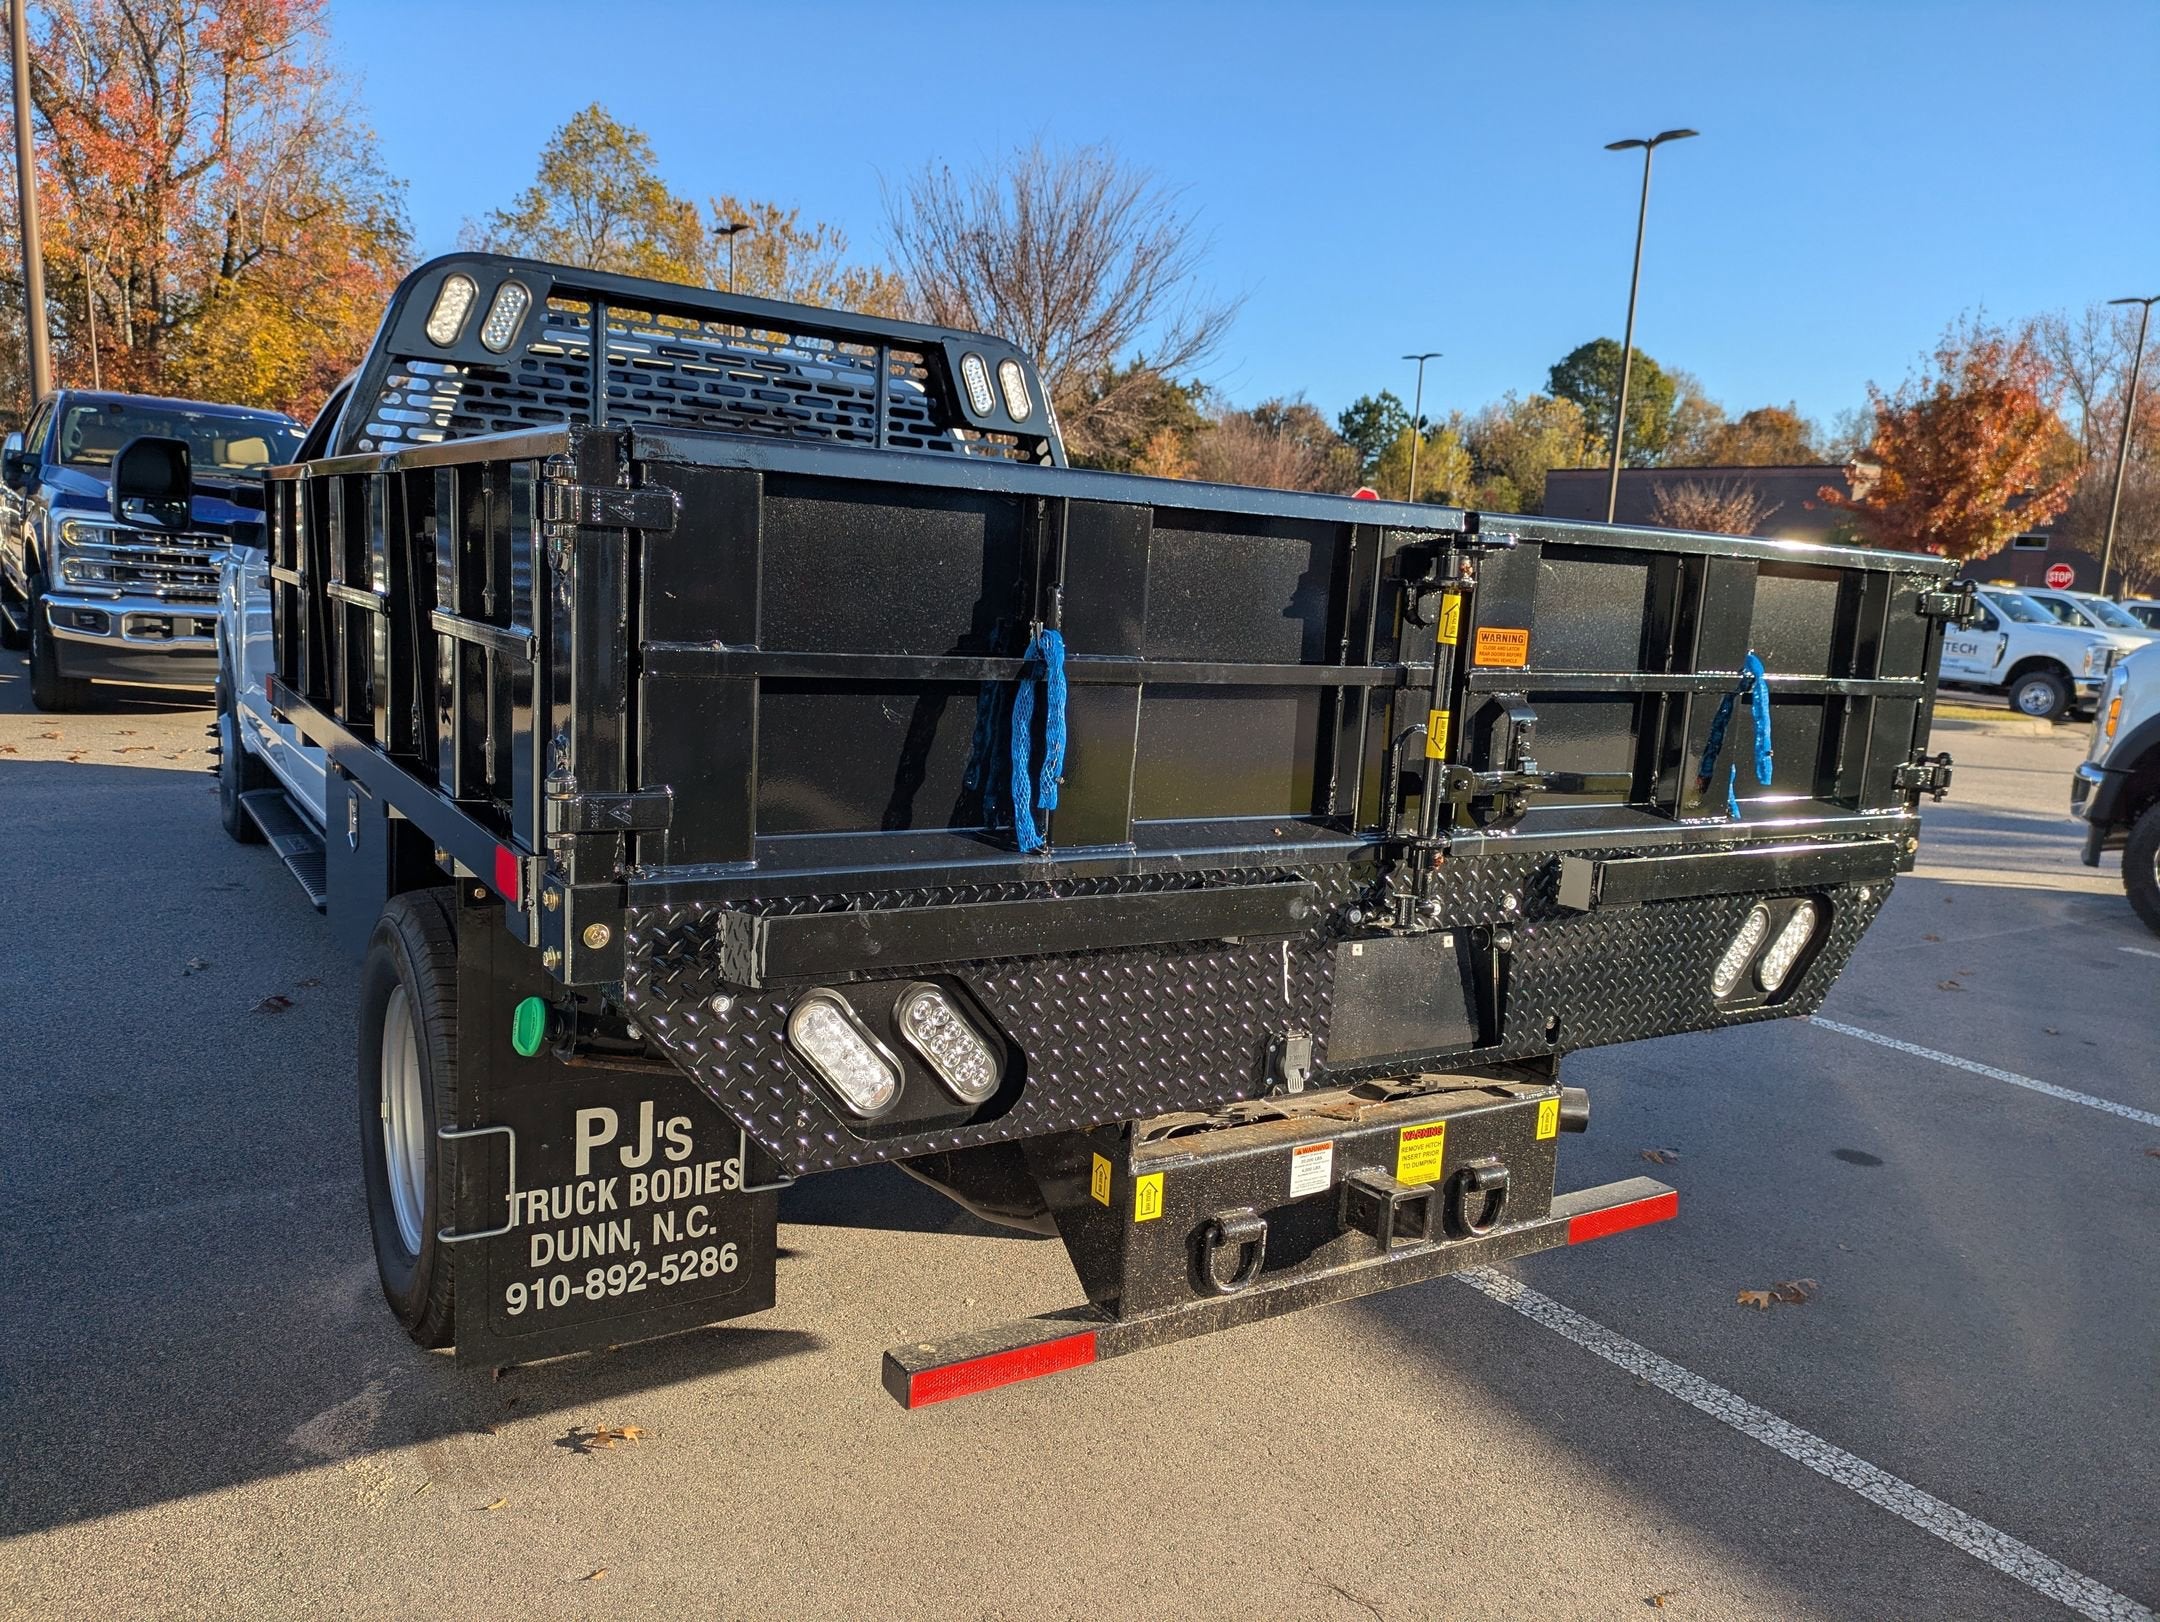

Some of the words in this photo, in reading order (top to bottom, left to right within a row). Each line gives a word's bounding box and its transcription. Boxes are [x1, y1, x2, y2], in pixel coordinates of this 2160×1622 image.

[2048, 571, 2072, 583] STOP
[1481, 633, 1524, 643] WARNING
[1945, 642, 1978, 655] TECH
[1402, 1125, 1444, 1142] WARNING
[1302, 1143, 1329, 1153] WARNING
[1401, 1143, 1424, 1153] REMOVE
[1425, 1141, 1441, 1149] HITCH
[1401, 1153, 1421, 1161] INSERT
[1411, 1158, 1437, 1168] DUMPING
[505, 1177, 618, 1226] TRUCK
[629, 1158, 740, 1207] BODIES
[530, 1218, 640, 1267] DUNN,
[653, 1205, 717, 1245] N.C.
[505, 1242, 738, 1315] 910-892-5286
